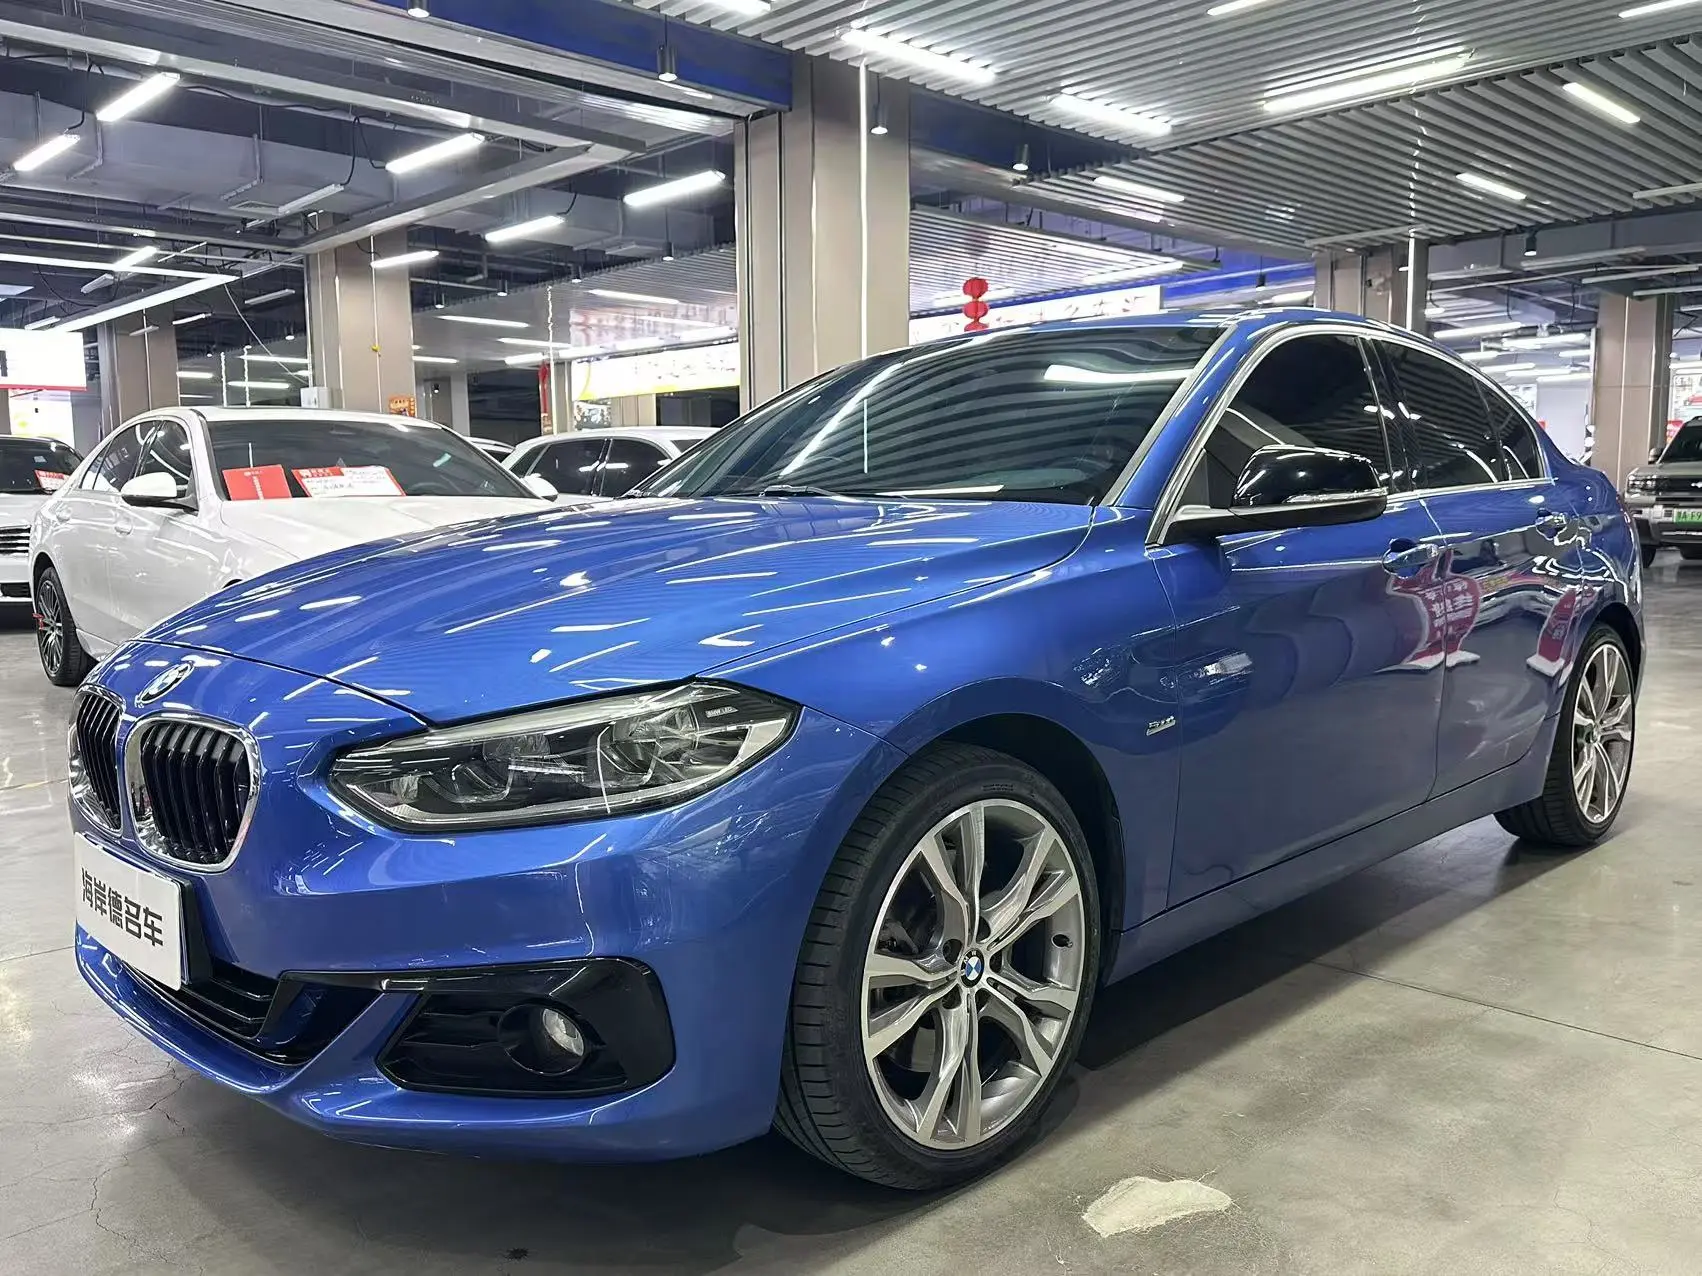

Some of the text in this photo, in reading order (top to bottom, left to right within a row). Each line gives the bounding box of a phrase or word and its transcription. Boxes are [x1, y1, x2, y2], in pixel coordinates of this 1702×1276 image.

[81, 867, 163, 947] 海岸德名车
